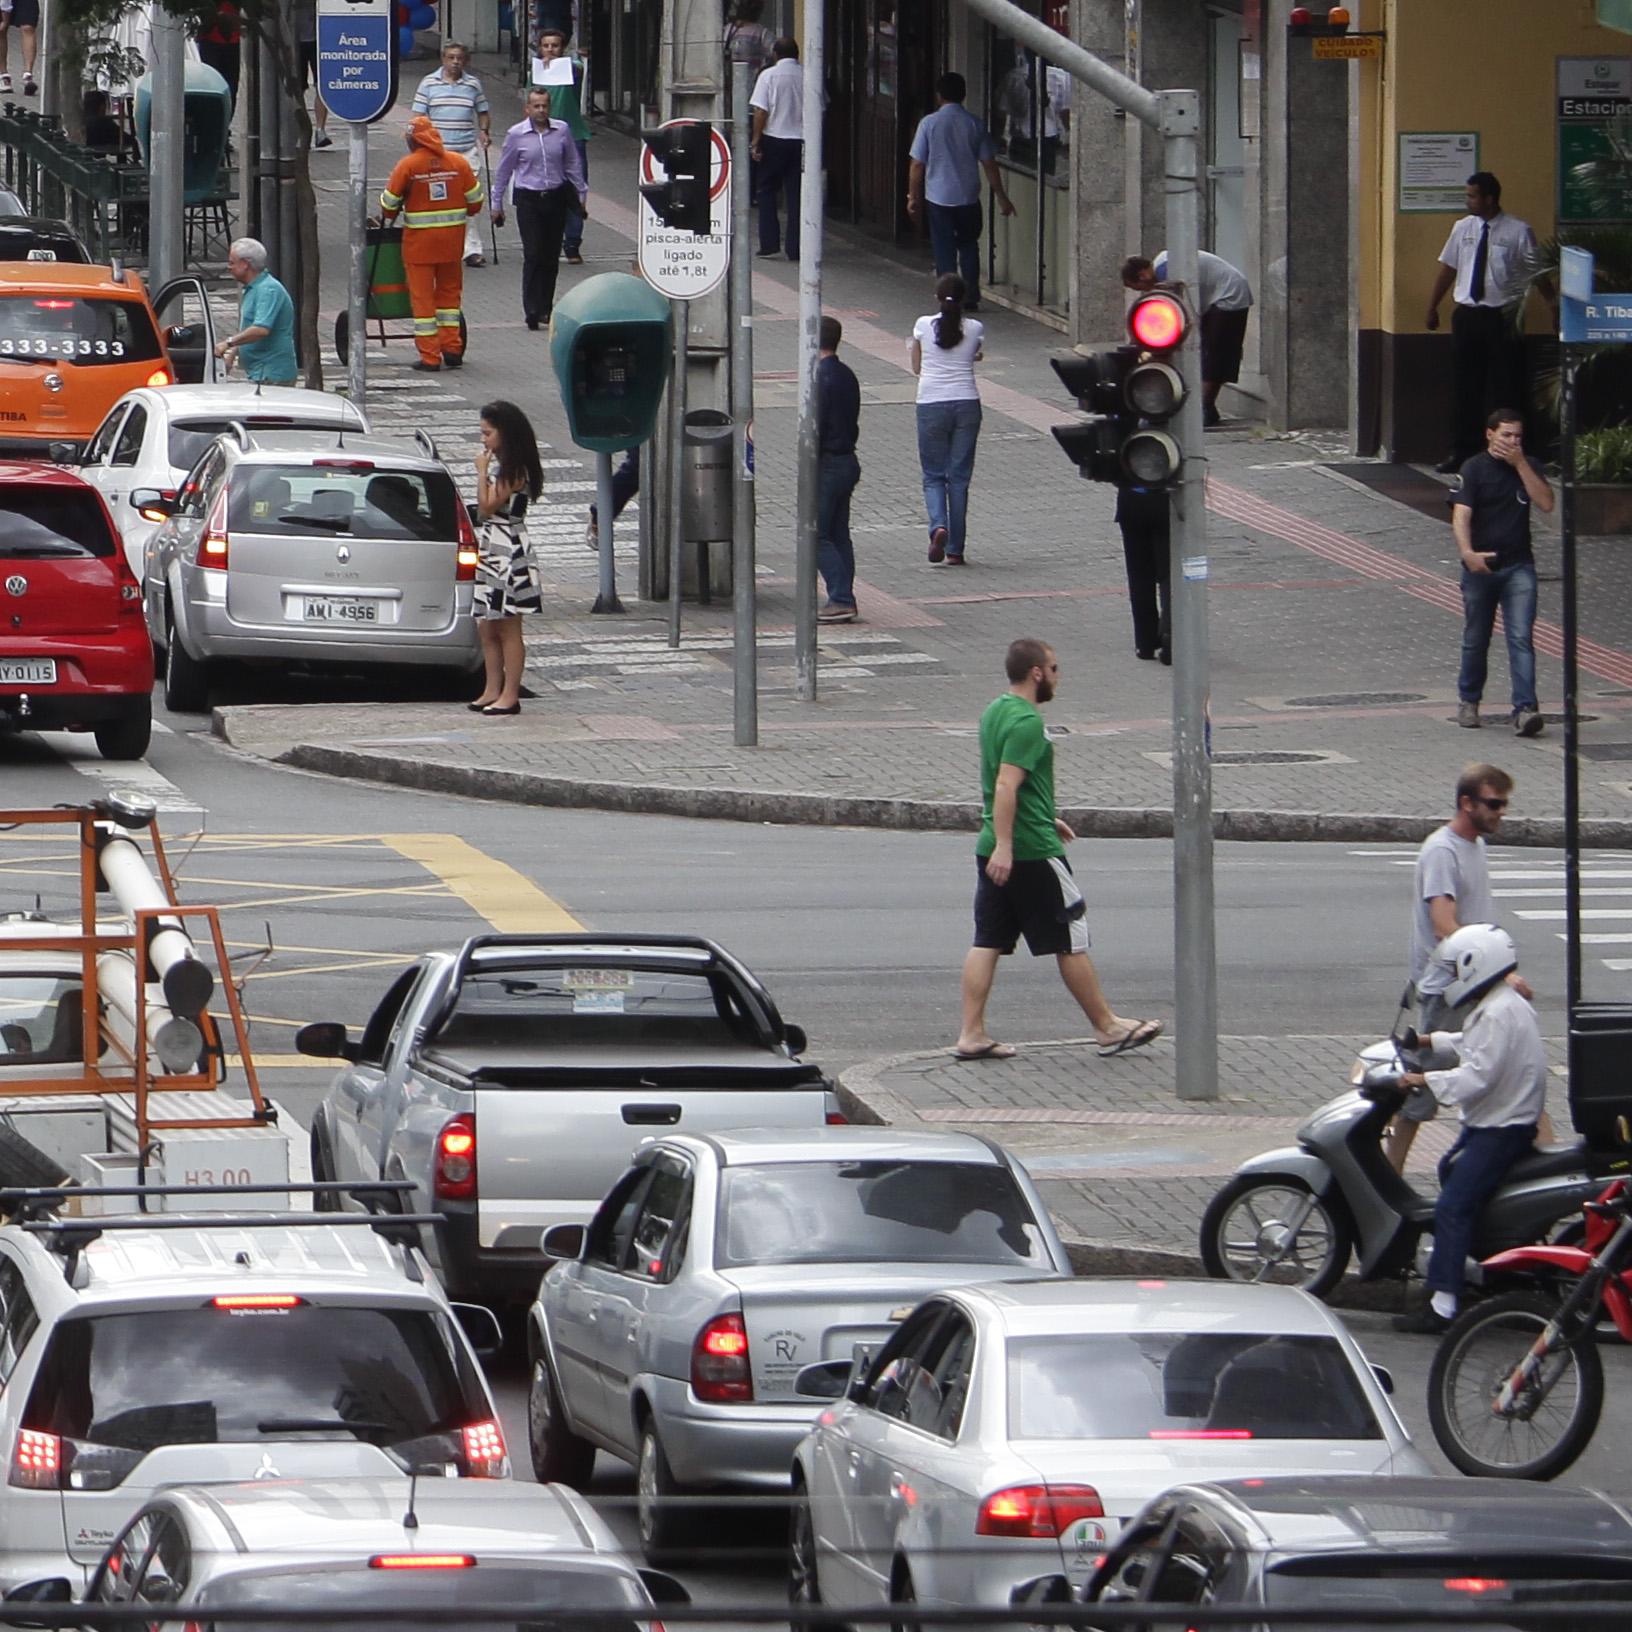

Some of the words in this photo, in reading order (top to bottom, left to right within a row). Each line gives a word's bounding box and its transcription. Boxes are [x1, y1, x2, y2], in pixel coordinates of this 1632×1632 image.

[339, 33, 368, 46] Área
[1318, 37, 1373, 48] CUIDADO
[320, 50, 387, 61] monitorada
[343, 66, 364, 77] por
[328, 78, 380, 90] câmeras
[645, 234, 724, 246] pisca-alerta
[664, 249, 704, 262] ligado
[659, 265, 679, 277] até
[1585, 306, 1601, 319] R.
